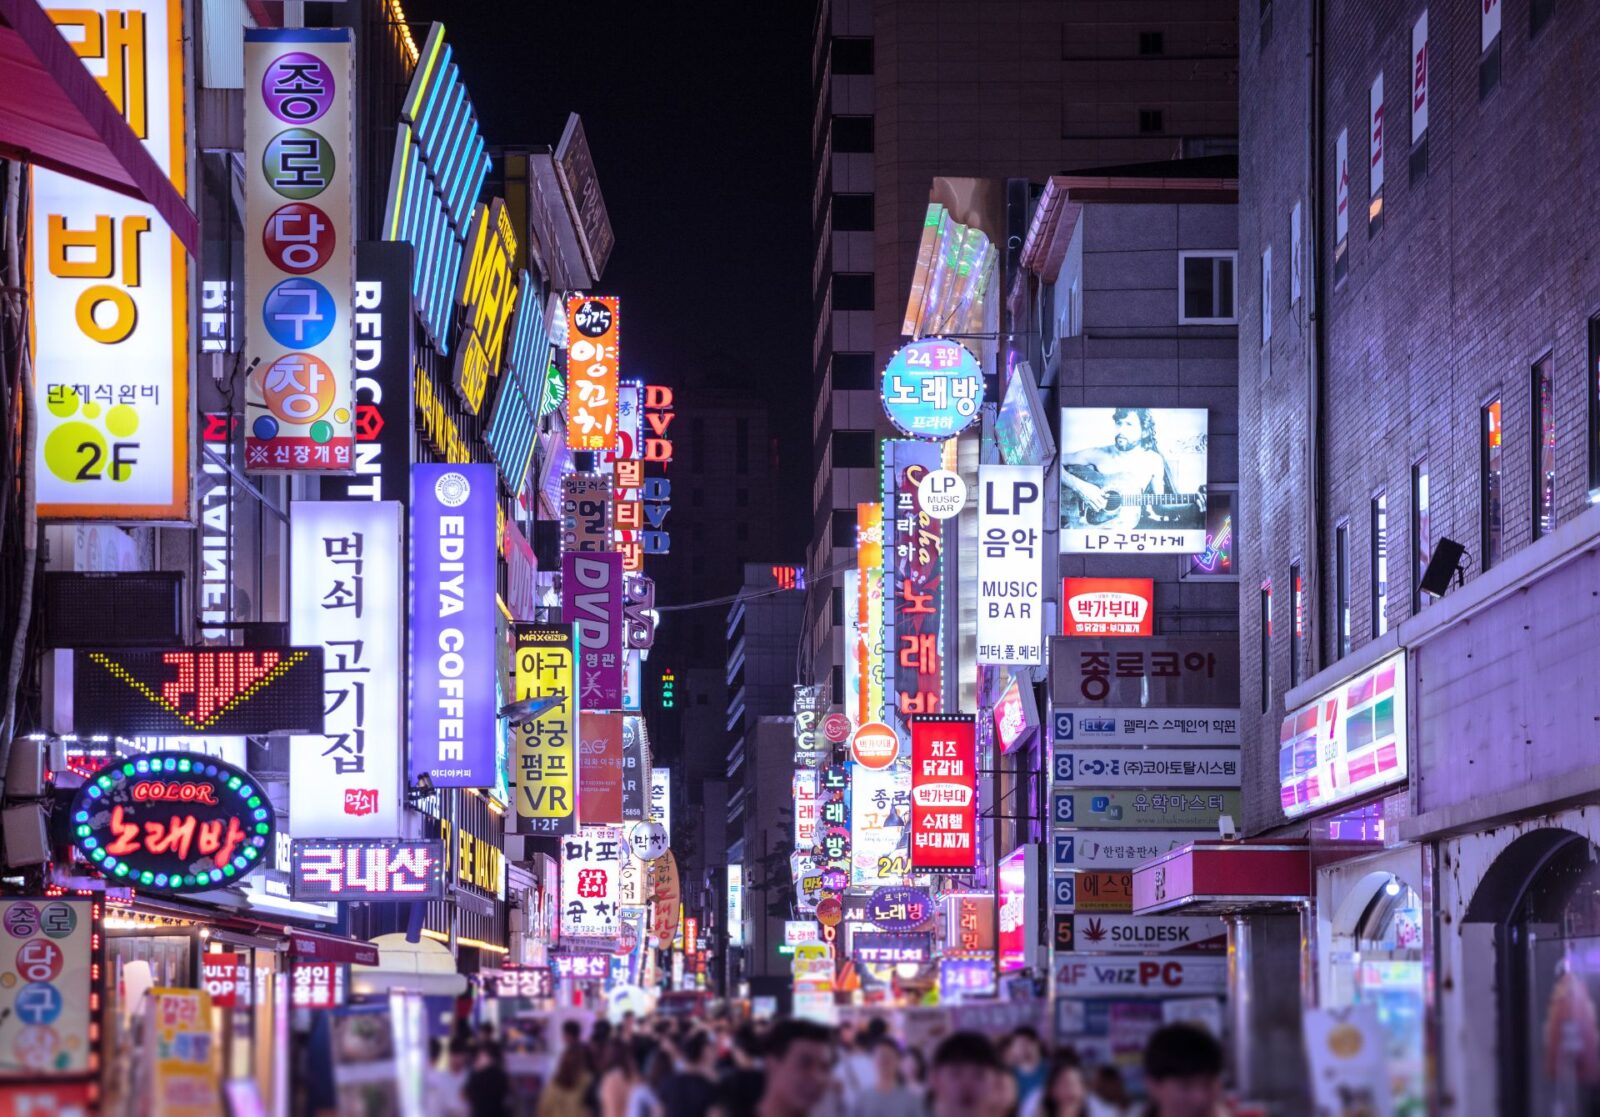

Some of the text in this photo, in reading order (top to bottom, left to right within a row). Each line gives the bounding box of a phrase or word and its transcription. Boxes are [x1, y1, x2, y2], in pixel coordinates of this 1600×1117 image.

[463, 204, 518, 377] MAX
[906, 348, 932, 367] 24
[47, 383, 160, 406] 단체석완비
[887, 375, 980, 417] 노래방
[645, 386, 676, 461] DVD
[911, 416, 953, 430] 프라하
[75, 441, 141, 481] 2F
[274, 445, 351, 464] 신장개업
[930, 477, 956, 494] LP
[927, 496, 960, 504] MUSIC
[985, 481, 1039, 516] LP
[641, 477, 672, 555] DVD
[897, 492, 916, 563] 프라하
[983, 527, 1038, 560] 음악
[1085, 533, 1185, 551] LP 구멍가게
[982, 580, 1038, 599] MUSIC
[574, 557, 610, 650] DVD
[988, 602, 1032, 620] BAR
[1077, 600, 1139, 618] 박가부대
[438, 516, 465, 761] EDIYA COFFEE
[320, 532, 372, 775] 먹쇠 고기집
[979, 644, 1040, 661] 피터.폴.메리
[521, 653, 568, 680] 야구
[1080, 651, 1217, 701] 종로코아
[521, 719, 569, 748] 양궁
[797, 711, 815, 750] PC
[1056, 718, 1072, 737] 9
[1124, 719, 1159, 734] 펠리스
[1162, 719, 1210, 734] 스페인어
[1212, 719, 1236, 734] 학원
[931, 741, 957, 757] 치즈
[431, 769, 472, 779] 이디야커피
[521, 754, 569, 781] 펌프
[922, 760, 964, 777] 닭갈비
[1057, 757, 1071, 777] 8
[1123, 760, 1237, 776] (주)코아토탈시스템
[133, 782, 218, 805] COLOR
[523, 785, 569, 811] VR
[871, 788, 911, 811] 종로
[919, 789, 966, 803] 박가부대
[1132, 794, 1224, 814] 유학마스터
[798, 786, 815, 839] 노래방
[825, 770, 845, 858] 노래방
[1057, 798, 1072, 819] 8
[922, 813, 963, 830] 수제햄
[105, 804, 246, 869] 노래방
[635, 832, 667, 850] 막창
[915, 832, 970, 849] 부대찌개
[565, 840, 618, 862] 마포
[1057, 840, 1072, 860] 7
[1103, 845, 1158, 859] 한림출판사
[300, 846, 431, 893] 국내산
[580, 883, 604, 897] 구이
[1057, 881, 1071, 901] 6
[9, 907, 73, 937] 종로
[566, 900, 619, 924] 곱창
[874, 903, 923, 921] 노래방
[960, 897, 979, 950] 노래방
[1057, 922, 1071, 942] 5
[1111, 926, 1190, 942] SOLDESK
[293, 965, 330, 985] 성인
[555, 956, 606, 977] 부동산
[1056, 963, 1087, 986] 4F
[1138, 961, 1184, 988] PC
